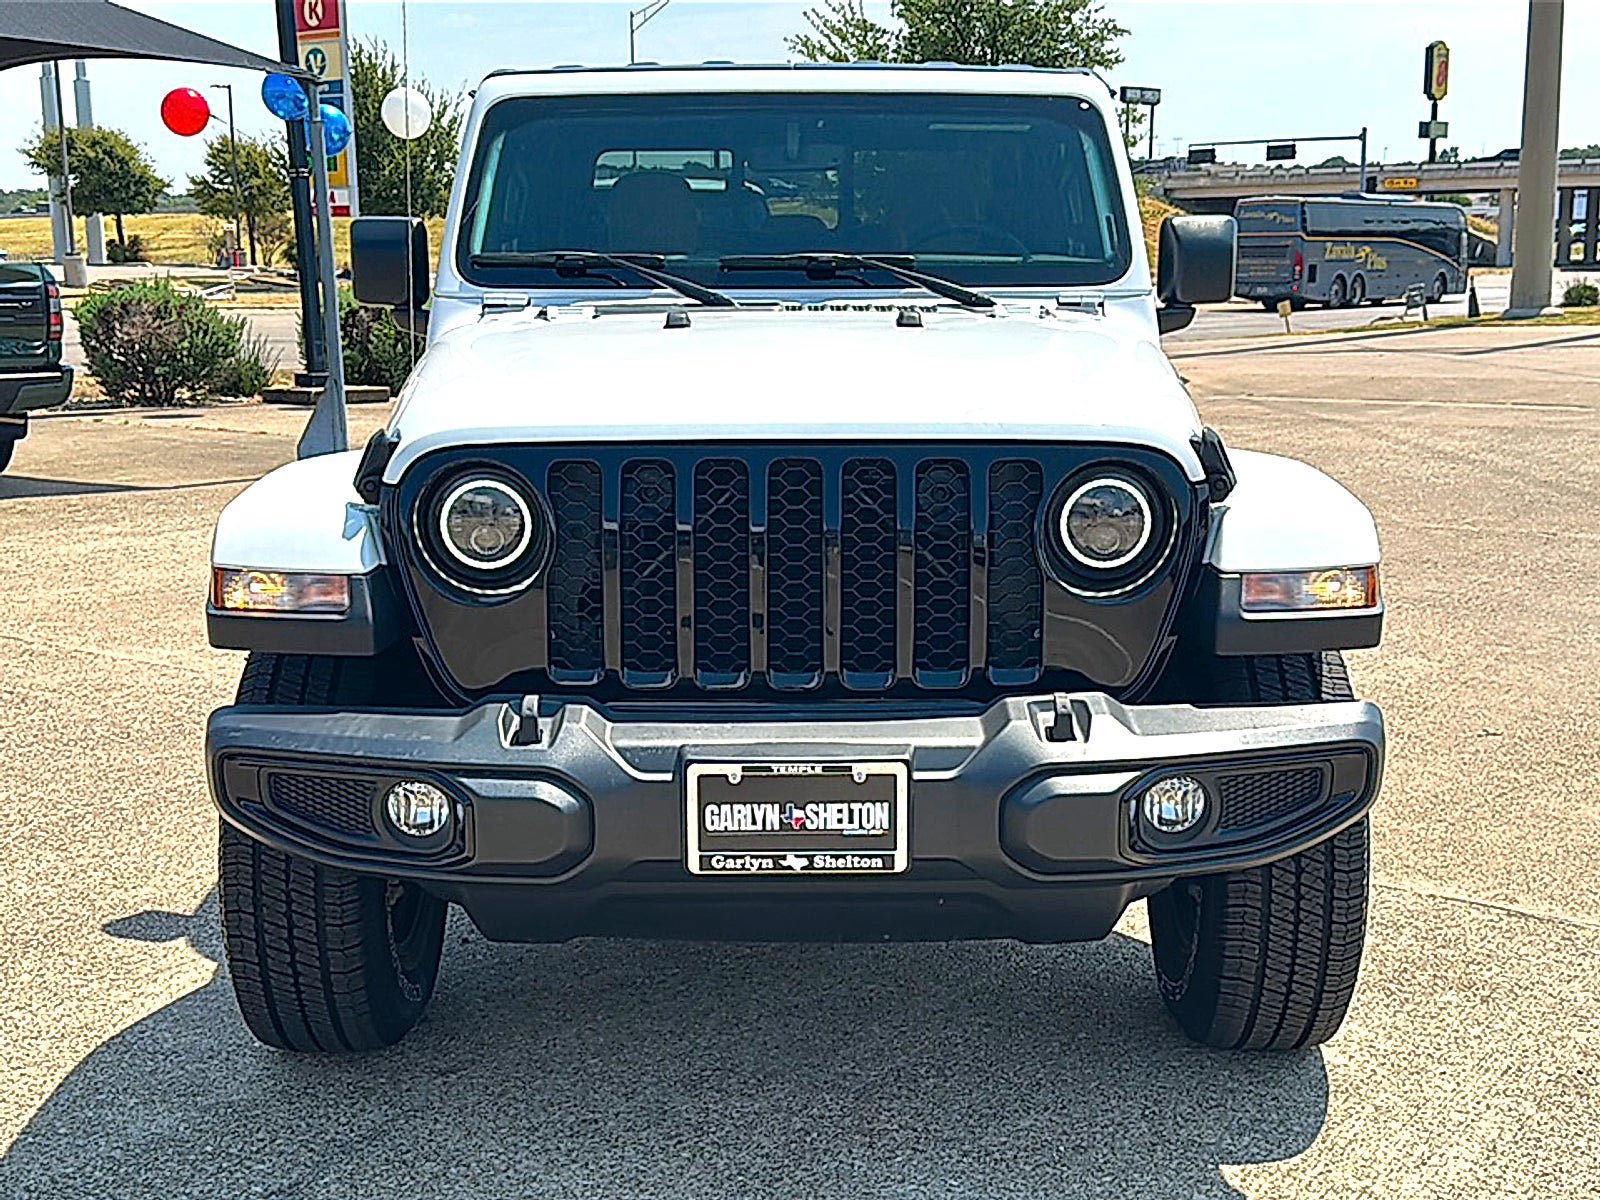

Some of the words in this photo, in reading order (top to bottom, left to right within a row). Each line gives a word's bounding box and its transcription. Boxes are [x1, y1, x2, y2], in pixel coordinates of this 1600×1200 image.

[308, 1, 322, 21] K
[770, 765, 823, 774] TEMPLE
[705, 803, 780, 831] GARLYN
[805, 802, 890, 830] SHELTON
[710, 855, 774, 871] Garlyn
[813, 854, 883, 869] Shelton
